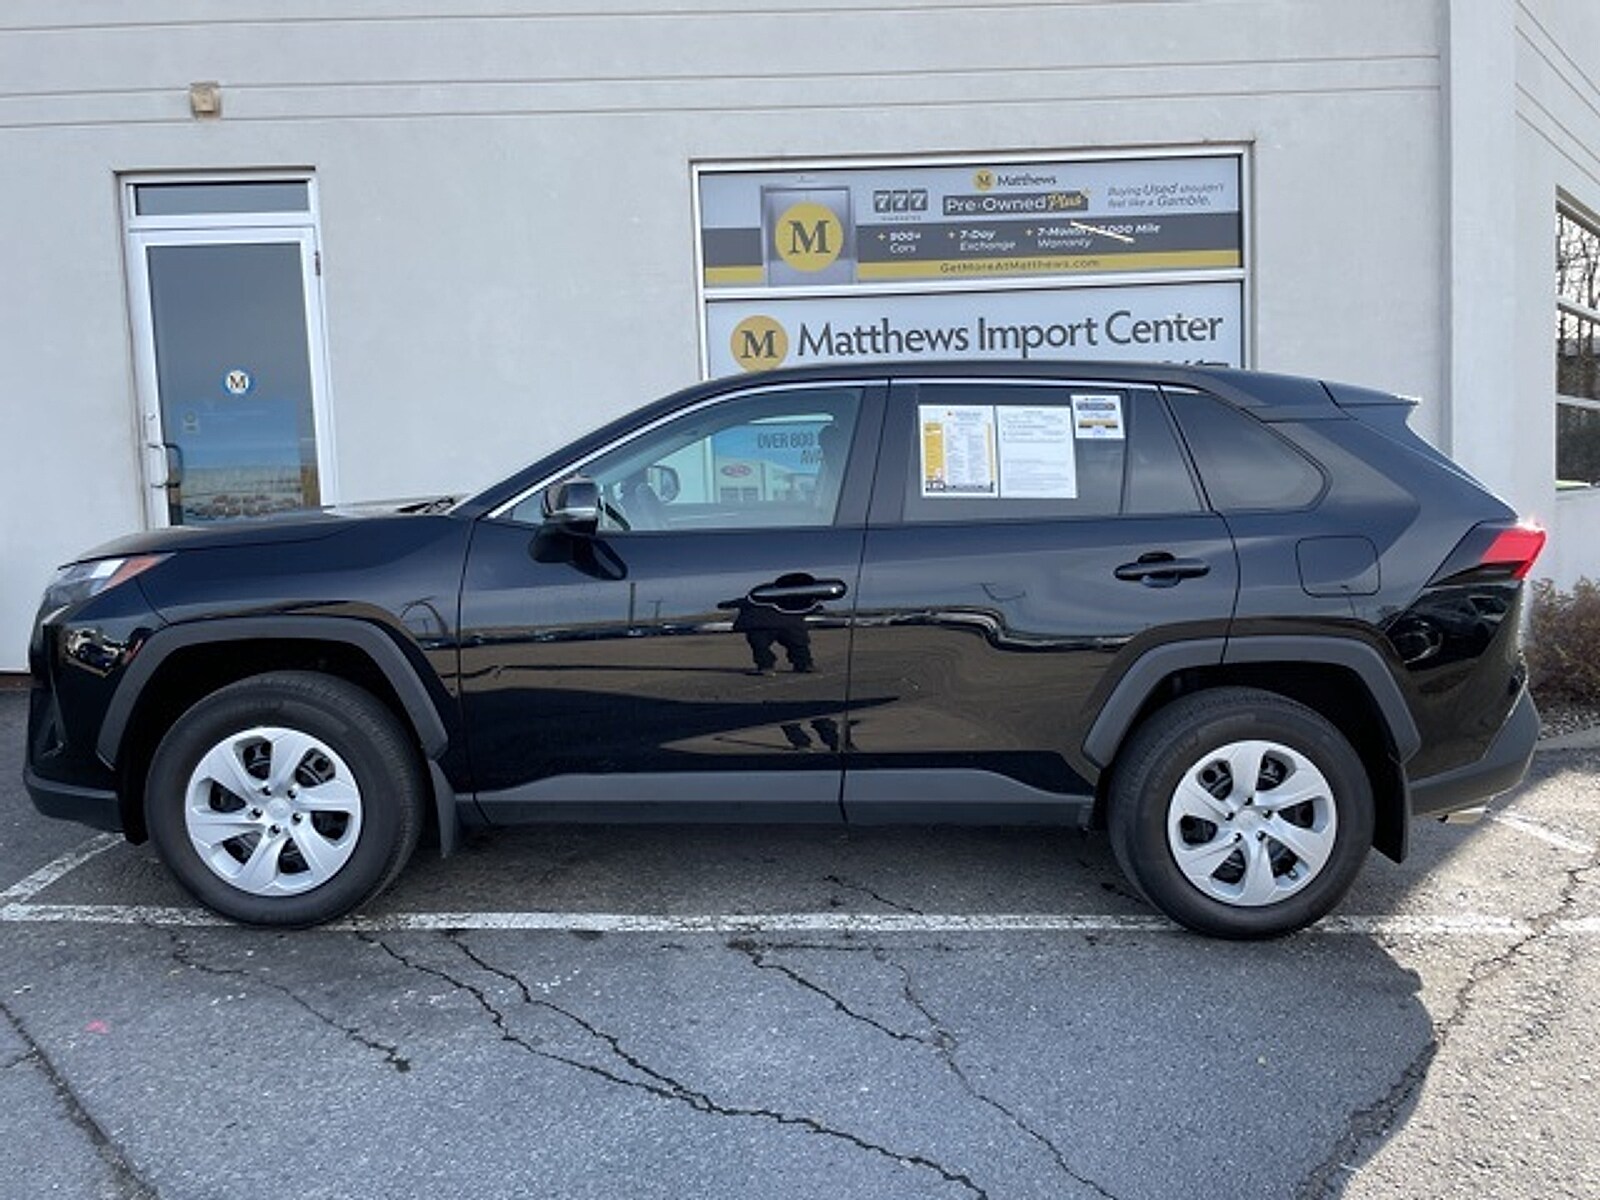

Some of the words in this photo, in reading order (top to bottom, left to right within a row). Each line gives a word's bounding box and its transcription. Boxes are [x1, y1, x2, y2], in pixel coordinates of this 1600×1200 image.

[997, 172, 1057, 186] Matthews
[1143, 182, 1178, 196] Used
[788, 220, 831, 254] M
[1037, 238, 1093, 249] Warranty
[889, 242, 917, 253] Cars
[959, 240, 1016, 252] Exchange
[740, 330, 779, 358] M
[797, 317, 969, 357] Matthews
[978, 316, 1099, 359] Import
[1105, 309, 1223, 345] Center
[757, 432, 788, 449] OVER
